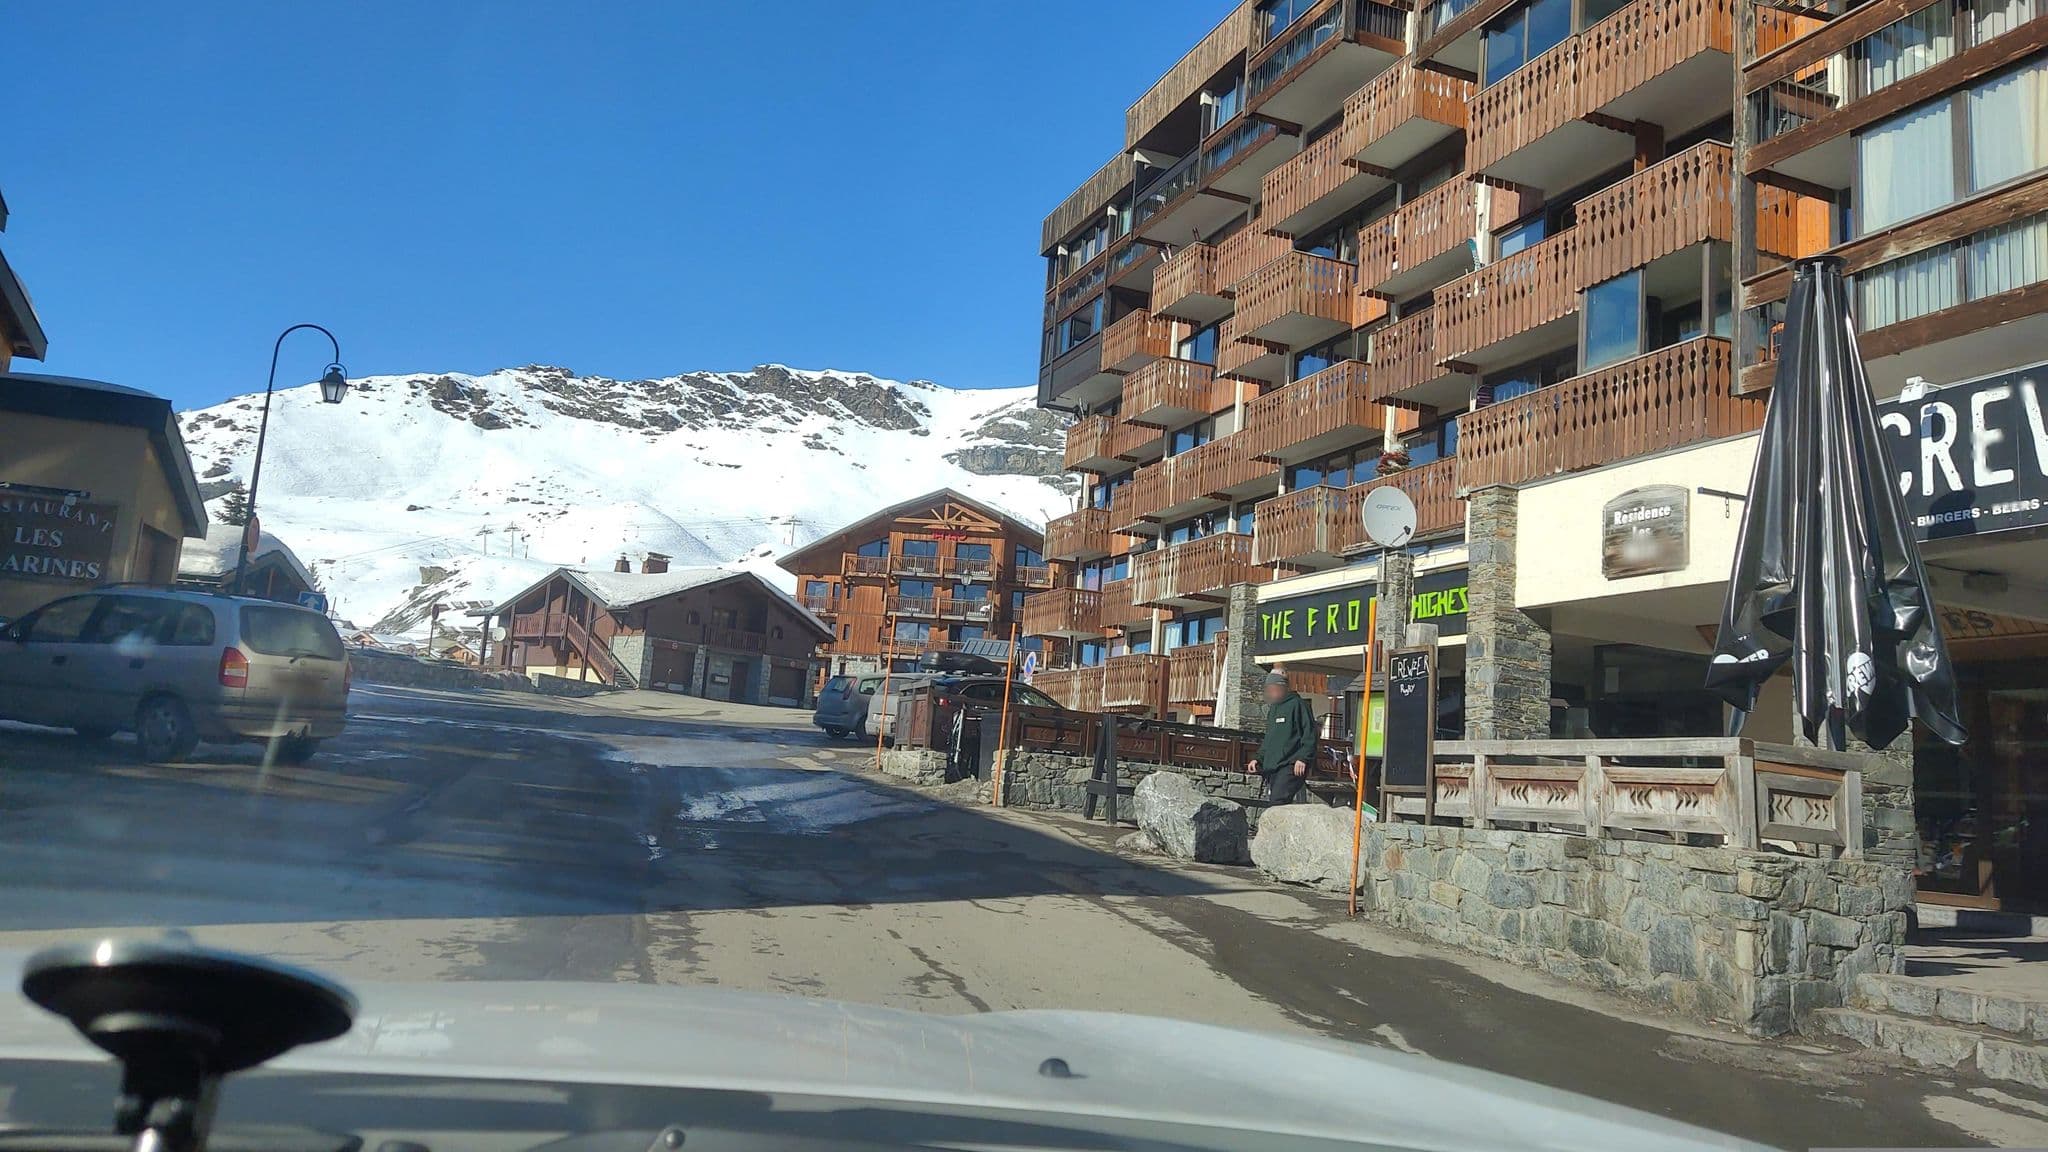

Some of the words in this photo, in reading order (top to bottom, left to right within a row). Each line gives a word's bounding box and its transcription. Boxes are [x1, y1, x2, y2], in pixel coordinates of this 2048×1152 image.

[1917, 508, 1981, 527] BURGERS
[1992, 498, 2040, 515] BEERS
[14, 527, 63, 548] LES
[1261, 610, 1295, 641] THE
[1308, 597, 1377, 637] FRO
